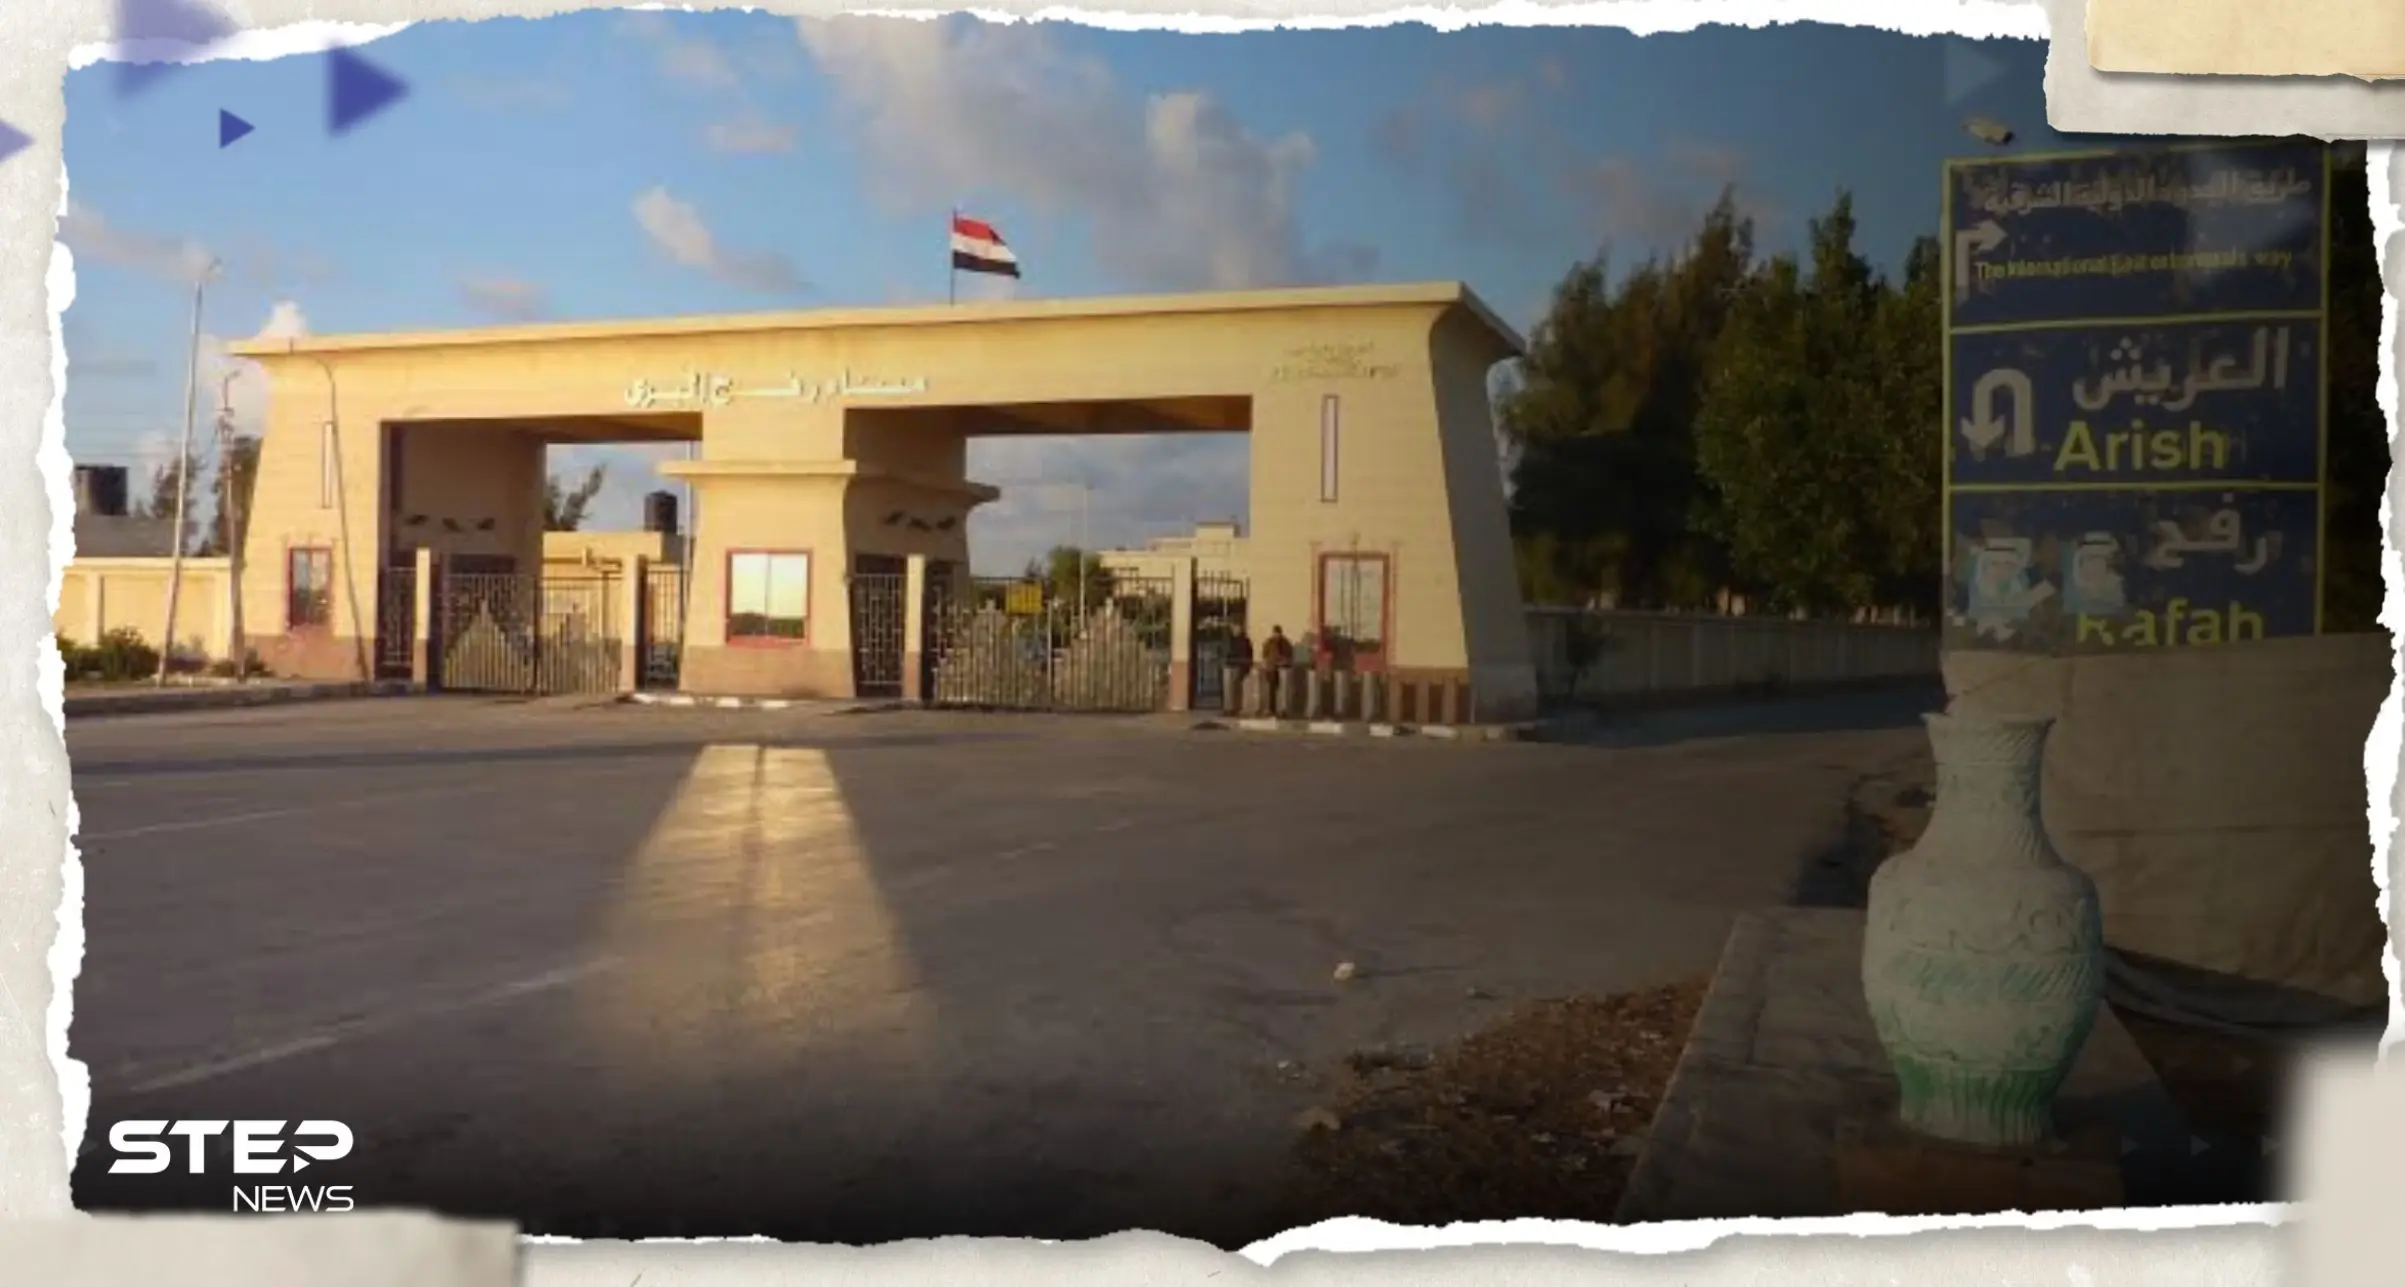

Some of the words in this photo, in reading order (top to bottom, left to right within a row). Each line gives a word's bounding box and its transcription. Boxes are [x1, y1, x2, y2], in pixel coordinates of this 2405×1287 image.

[2072, 325, 2290, 412] العريش
[2053, 419, 2226, 472] Arish
[2143, 491, 2277, 576] رفح
